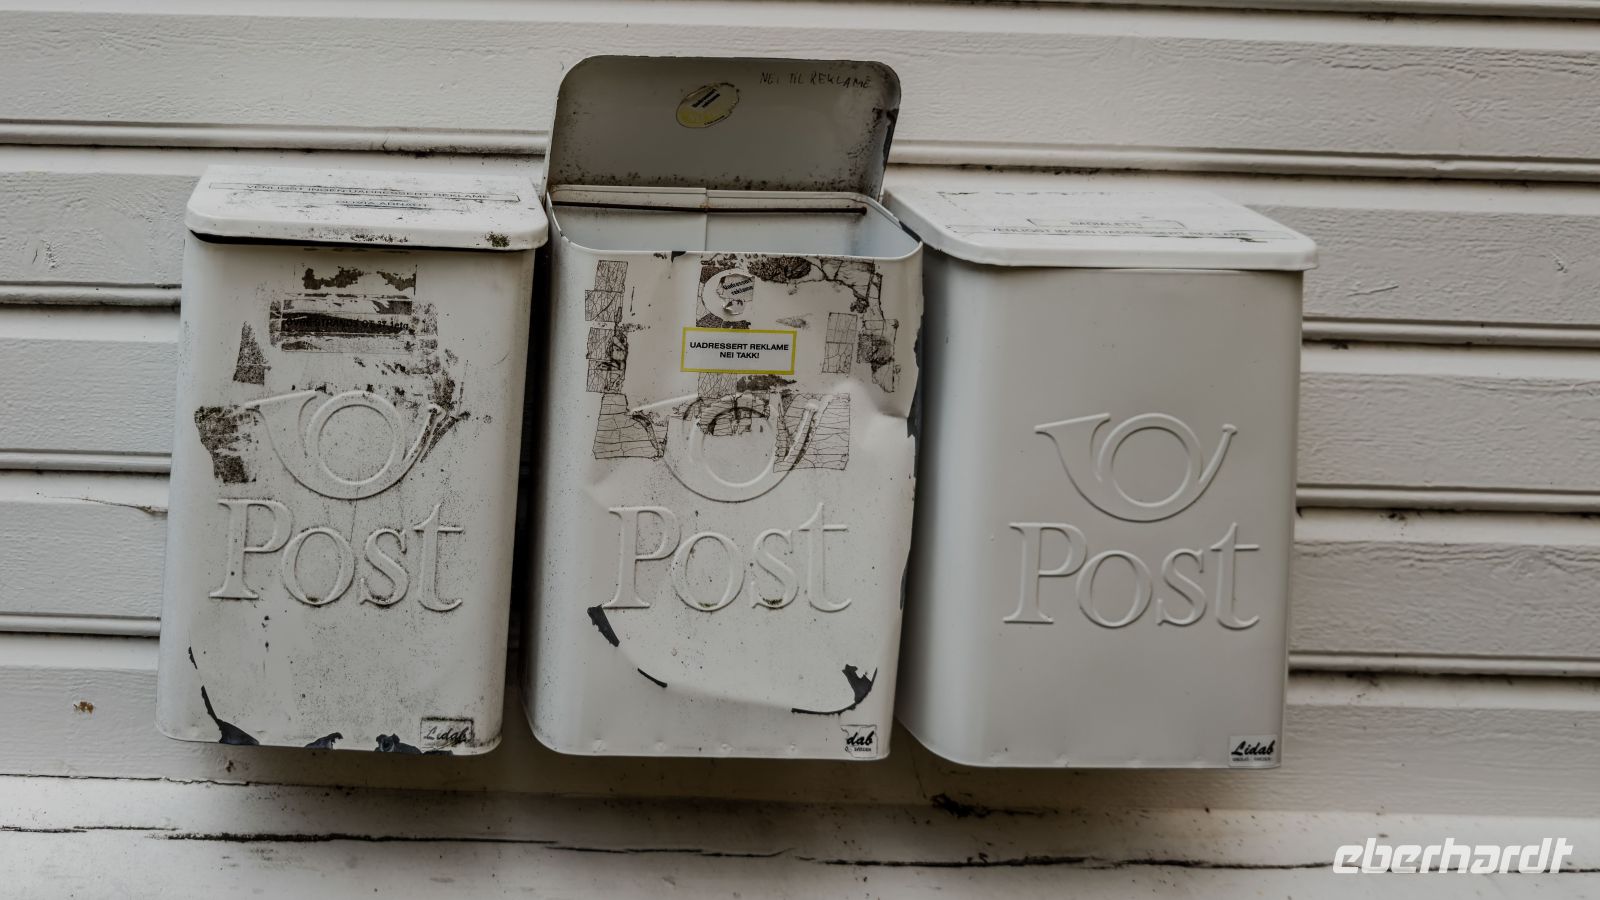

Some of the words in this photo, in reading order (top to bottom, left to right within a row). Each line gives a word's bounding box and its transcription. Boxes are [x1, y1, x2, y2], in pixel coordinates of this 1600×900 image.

[759, 71, 780, 85] NEI
[689, 341, 748, 350] UADRESSERT
[750, 343, 789, 351] REKLAME
[719, 351, 734, 359] NEI
[736, 351, 760, 359] TAKK!
[208, 497, 465, 613] Post
[601, 501, 852, 613] Post
[1002, 521, 1260, 631] Post
[1231, 739, 1276, 756] Lidab
